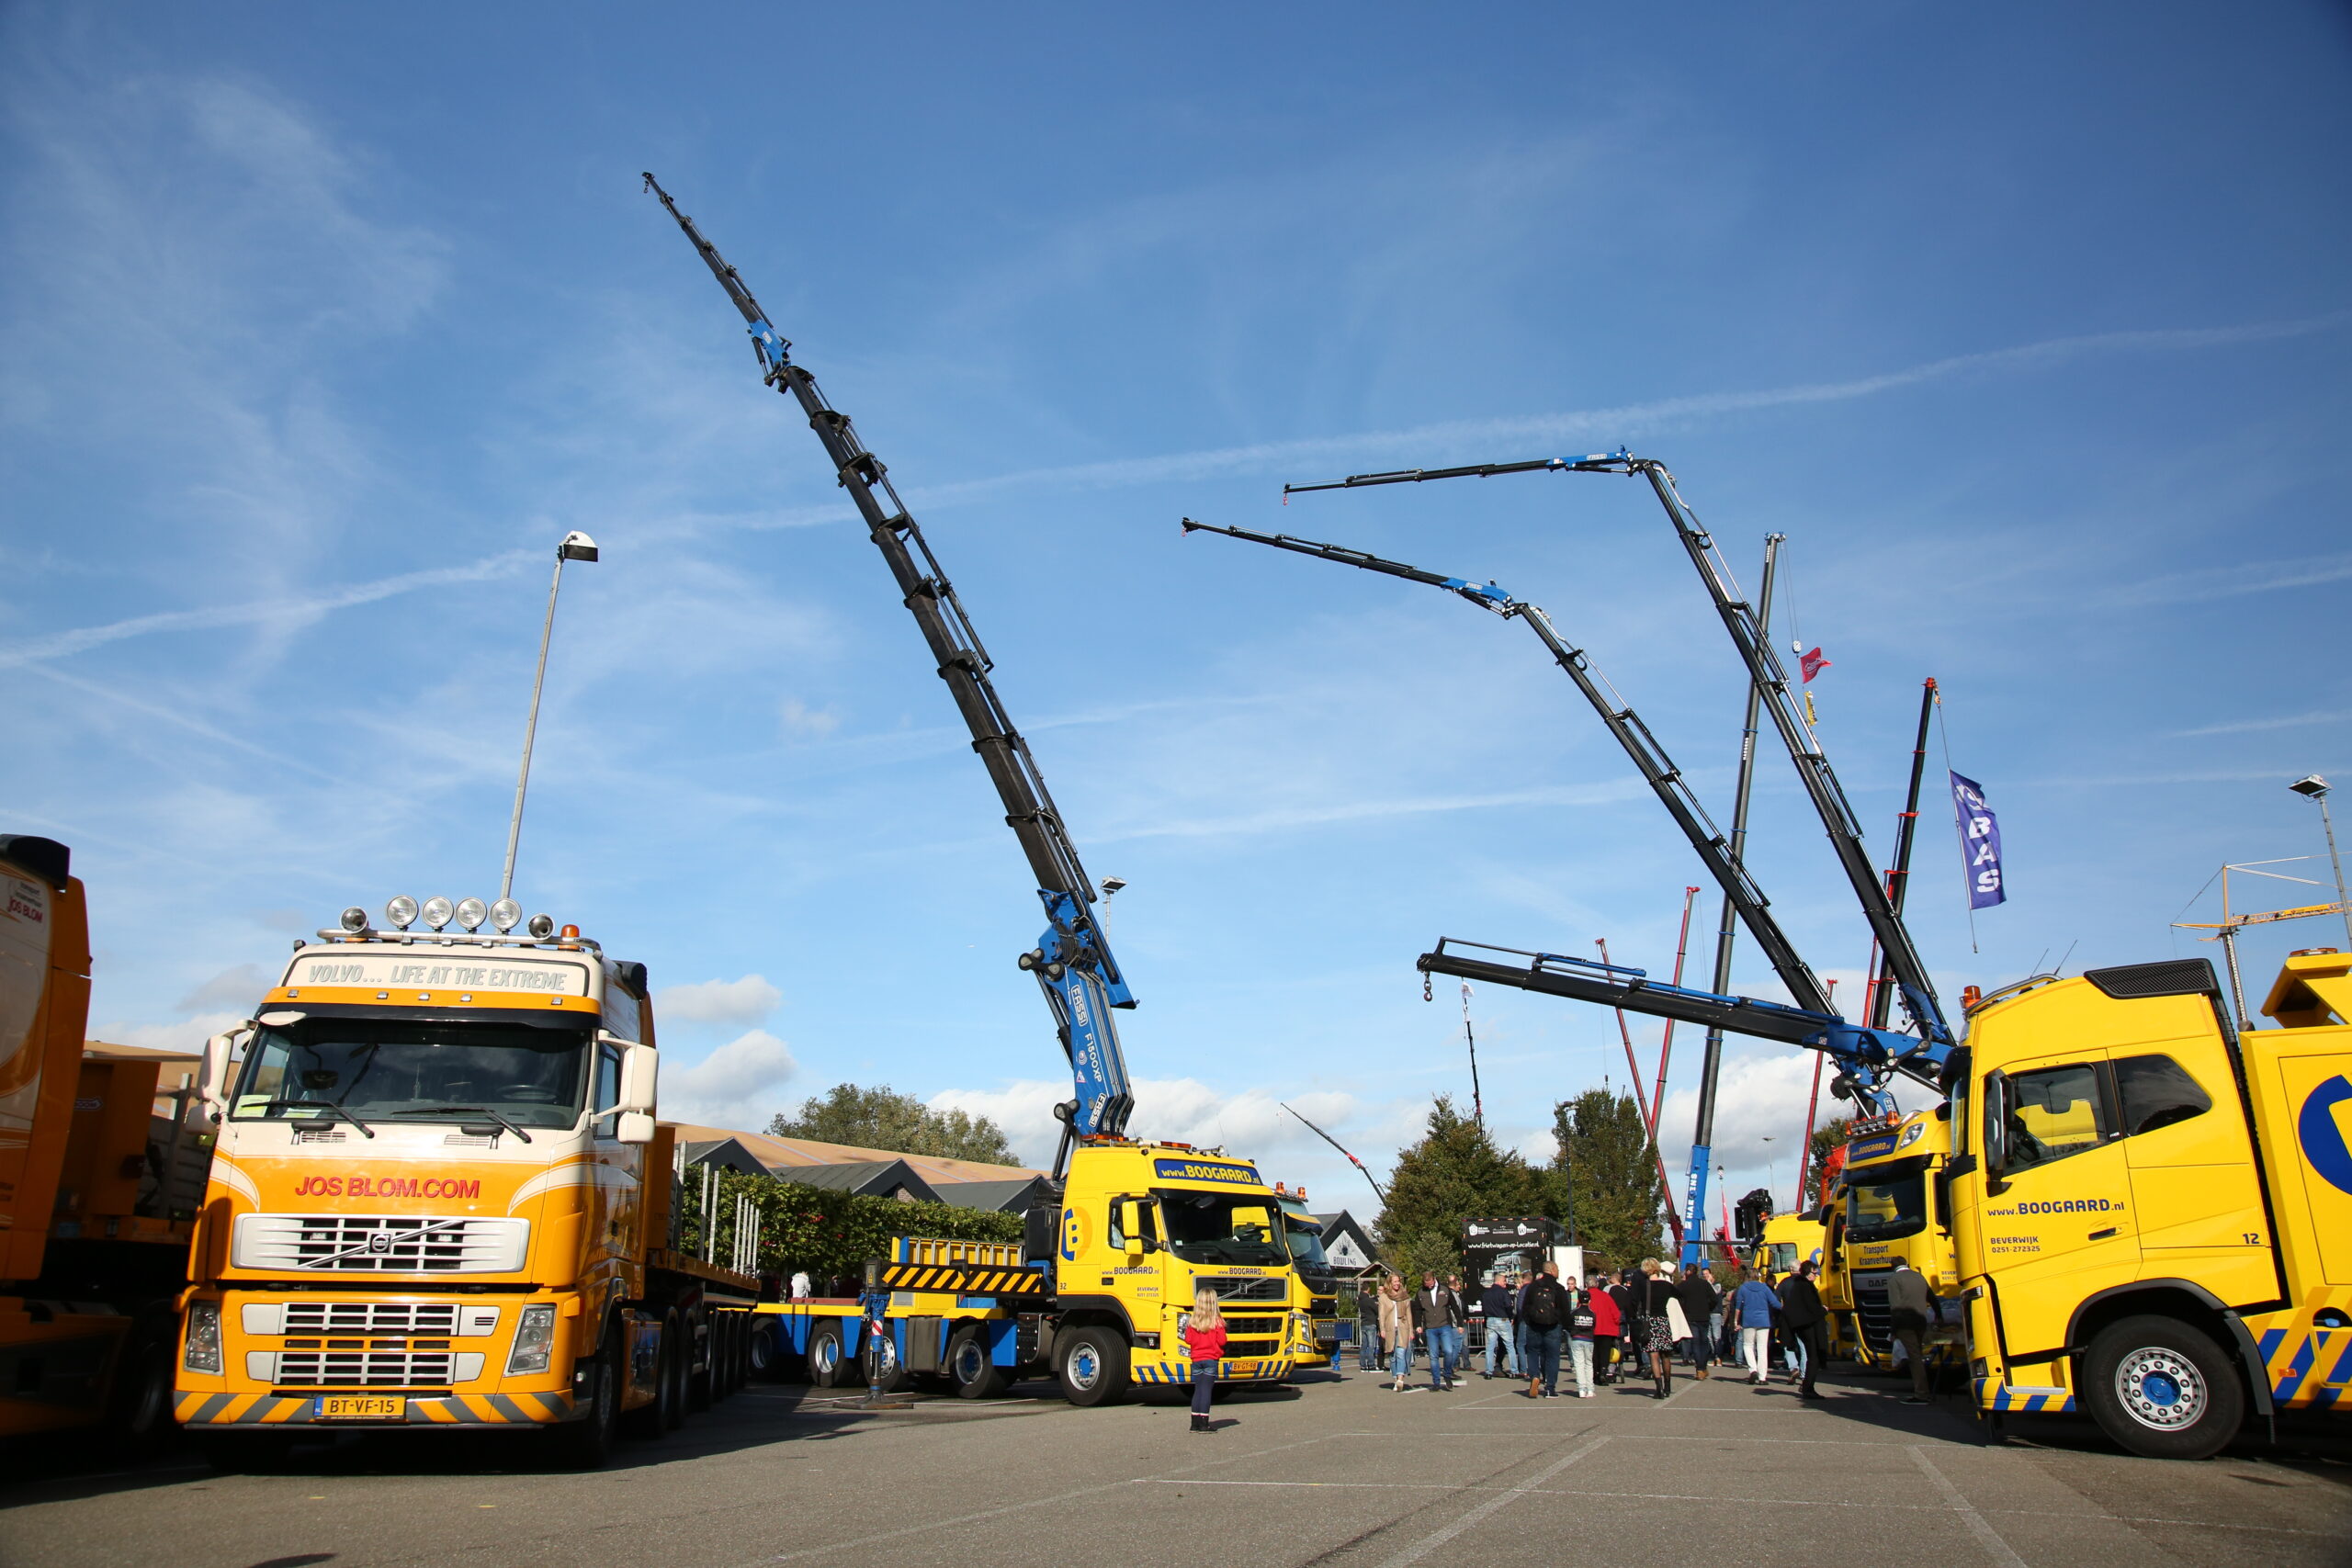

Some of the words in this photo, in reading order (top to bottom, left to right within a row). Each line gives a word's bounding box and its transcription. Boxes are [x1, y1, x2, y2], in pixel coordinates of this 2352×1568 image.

[7, 897, 22, 913] JOS
[22, 905, 43, 923] BLOM
[390, 965, 427, 984] LIFE
[427, 966, 452, 985] AT
[454, 967, 485, 986] THE
[488, 969, 568, 991] EXTREME
[1072, 986, 1087, 1026] FASSI
[1161, 1165, 1261, 1184] www.BOOGAARD.nl
[295, 1177, 343, 1196] JOS
[347, 1178, 480, 1199] BLOM.COM
[1686, 1173, 1698, 1219] HAEENS
[1987, 1199, 2125, 1216] www.BOOGAARD.nl
[1990, 1236, 2039, 1245] BEVERWIJK
[2243, 1234, 2260, 1245] 12
[1863, 1245, 1889, 1255] Transport
[1333, 1257, 1356, 1266] BOWLING
[1102, 1267, 1159, 1275] www.BOOGAARD.nl
[330, 1400, 394, 1413] BT-VF-15
